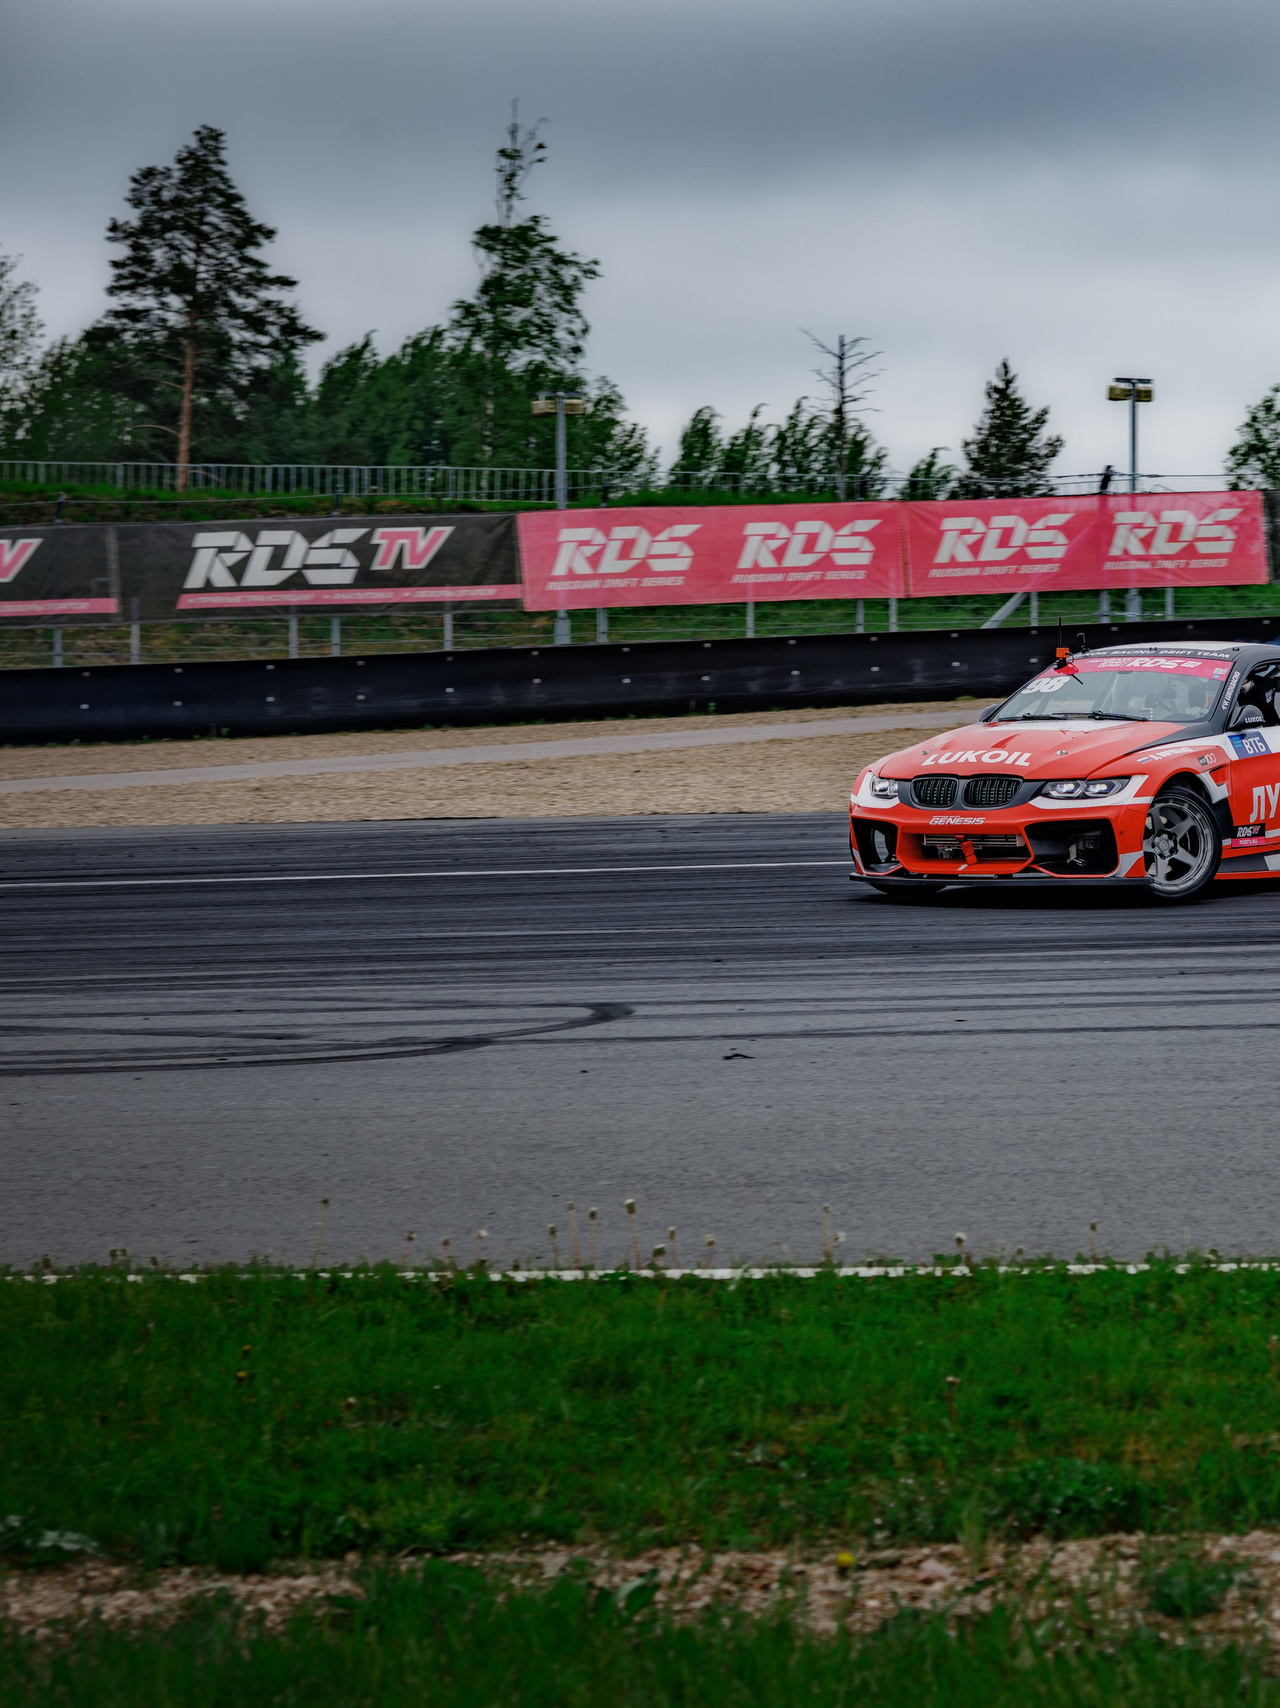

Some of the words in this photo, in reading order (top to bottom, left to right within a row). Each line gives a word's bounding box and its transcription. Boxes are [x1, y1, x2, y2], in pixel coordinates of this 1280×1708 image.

[933, 513, 1076, 564] RDS
[1108, 508, 1244, 556] RDS
[551, 523, 704, 577] RDS
[736, 519, 884, 569] RDS
[0, 537, 44, 583] V
[183, 527, 372, 590] RDS
[369, 525, 456, 571] TV
[1102, 561, 1153, 571] RUSSIAN
[1153, 559, 1189, 569] DRIFT
[1188, 558, 1230, 568] SERIES
[729, 573, 786, 583] RUSSIAN
[785, 571, 824, 581] DRIFT
[823, 570, 868, 580] SERIES
[928, 566, 983, 578] RUSSIAN
[981, 565, 1019, 575] DRIFT
[1017, 563, 1062, 574] SERIES
[544, 579, 602, 591] RUSSIAN
[601, 577, 641, 589] DRIFT
[639, 576, 686, 587] SERIES
[1126, 657, 1185, 670] RDS
[1196, 651, 1231, 659] TEAM
[1021, 676, 1071, 695] 98
[1242, 736, 1266, 755] ВТБ
[921, 750, 1033, 767] LUKOIL
[929, 817, 986, 825] GENESIS
[1236, 827, 1253, 838] RDS
